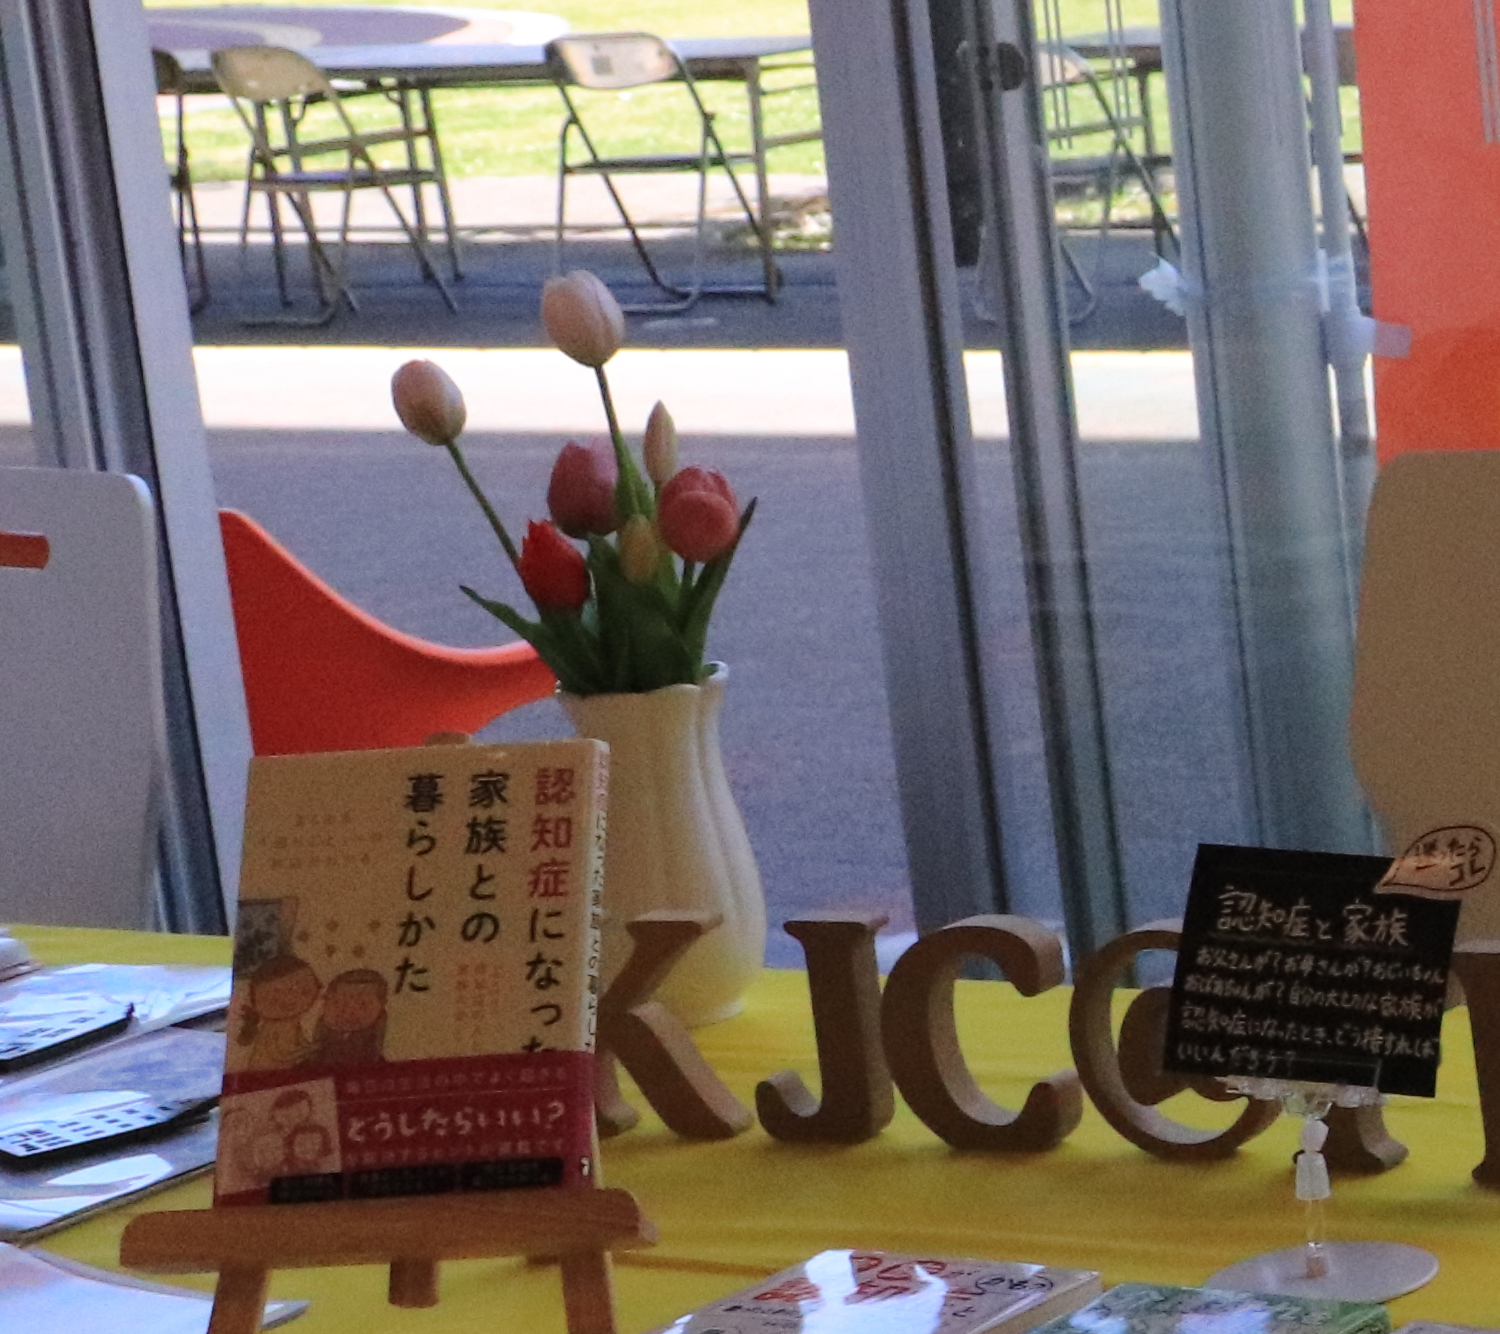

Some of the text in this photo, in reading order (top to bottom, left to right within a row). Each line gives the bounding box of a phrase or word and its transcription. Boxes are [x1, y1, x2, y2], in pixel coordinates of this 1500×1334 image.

[393, 772, 445, 996] 暮らしかた
[459, 769, 511, 945] 家族との
